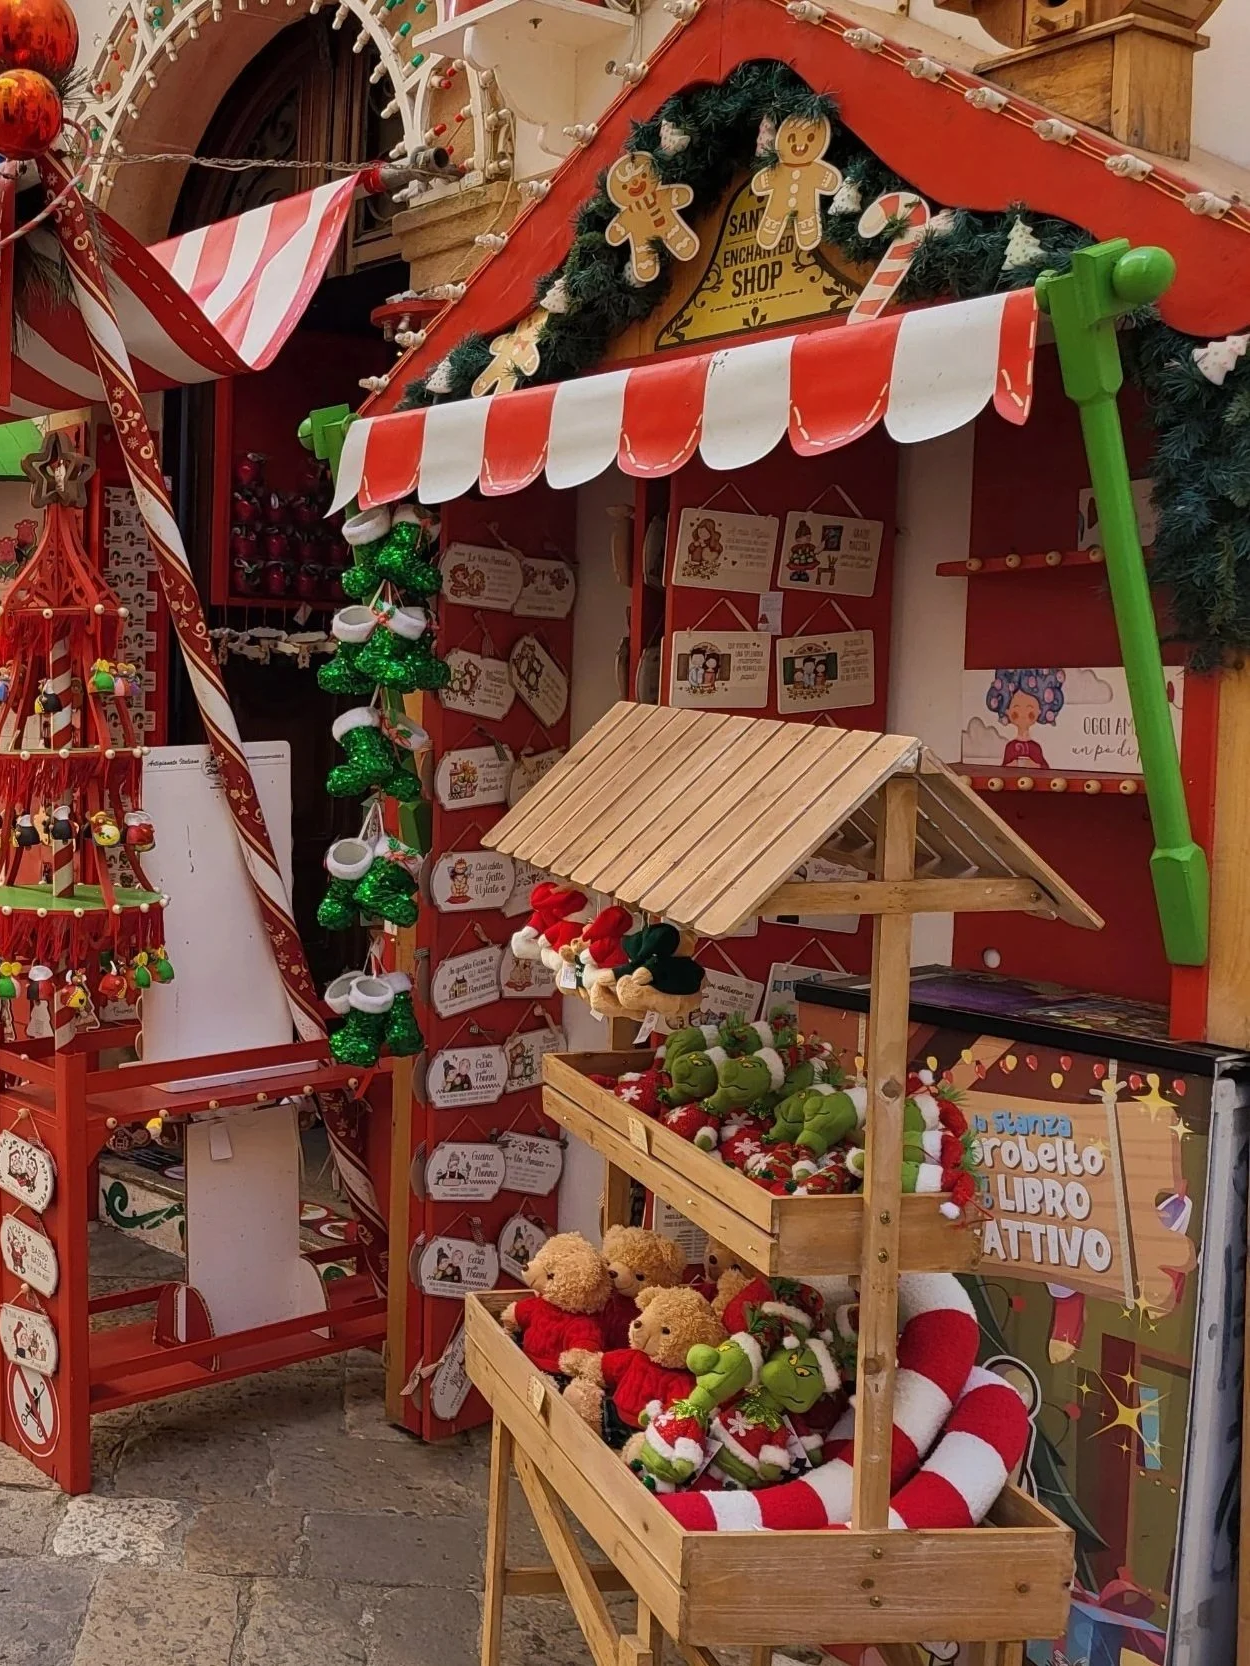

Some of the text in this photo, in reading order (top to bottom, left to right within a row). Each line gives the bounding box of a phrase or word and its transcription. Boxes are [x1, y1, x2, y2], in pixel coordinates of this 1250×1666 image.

[731, 260, 783, 298] SHOP
[1083, 716, 1134, 736] OGGI AM
[992, 1111, 1073, 1139] stanza
[997, 1174, 1092, 1221] LIBRO
[976, 1218, 1113, 1273] ATTIVO
